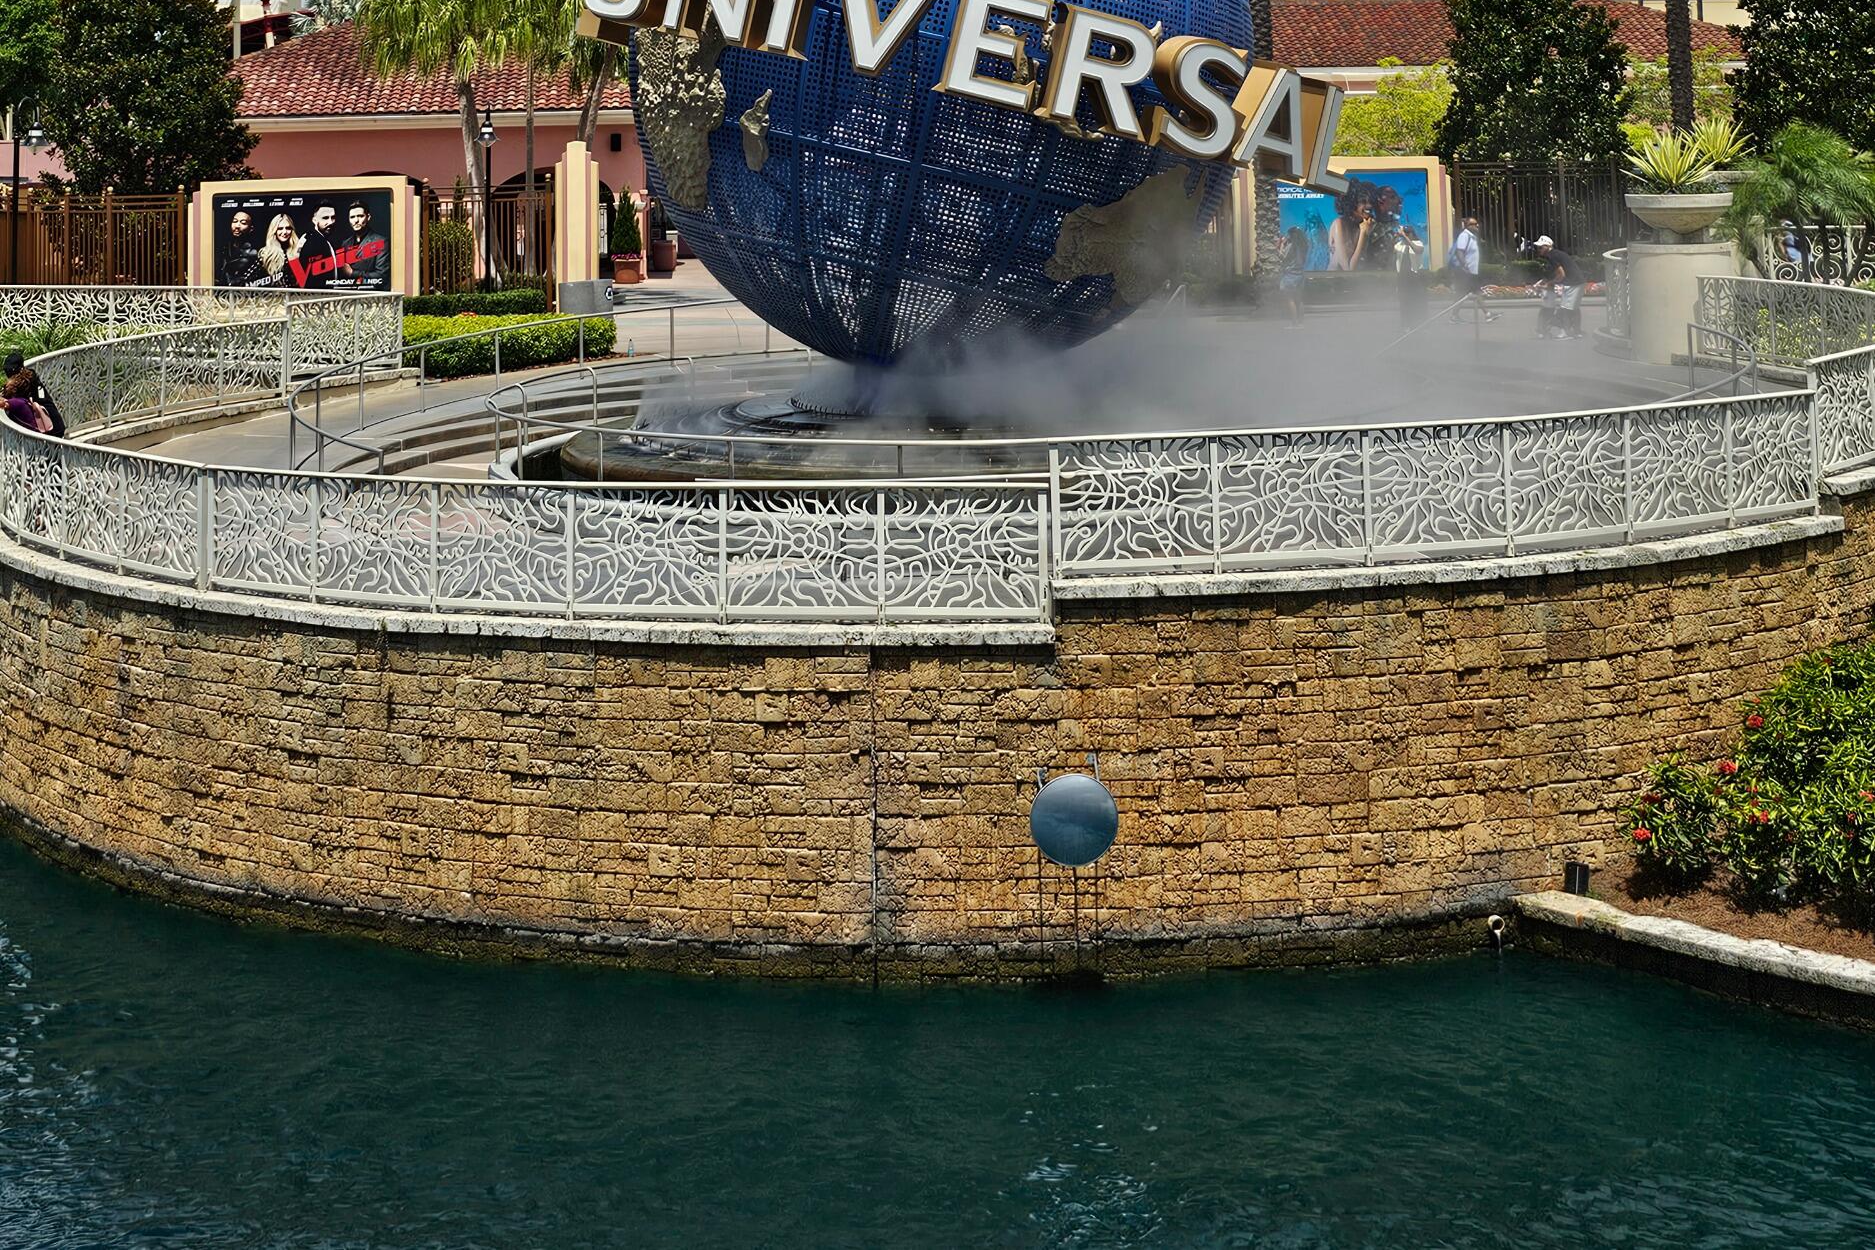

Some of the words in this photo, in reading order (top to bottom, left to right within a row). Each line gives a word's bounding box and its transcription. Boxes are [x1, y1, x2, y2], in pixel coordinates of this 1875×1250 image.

[272, 271, 284, 282] UP
[325, 278, 355, 286] MONDAY
[367, 277, 383, 285] NBC
